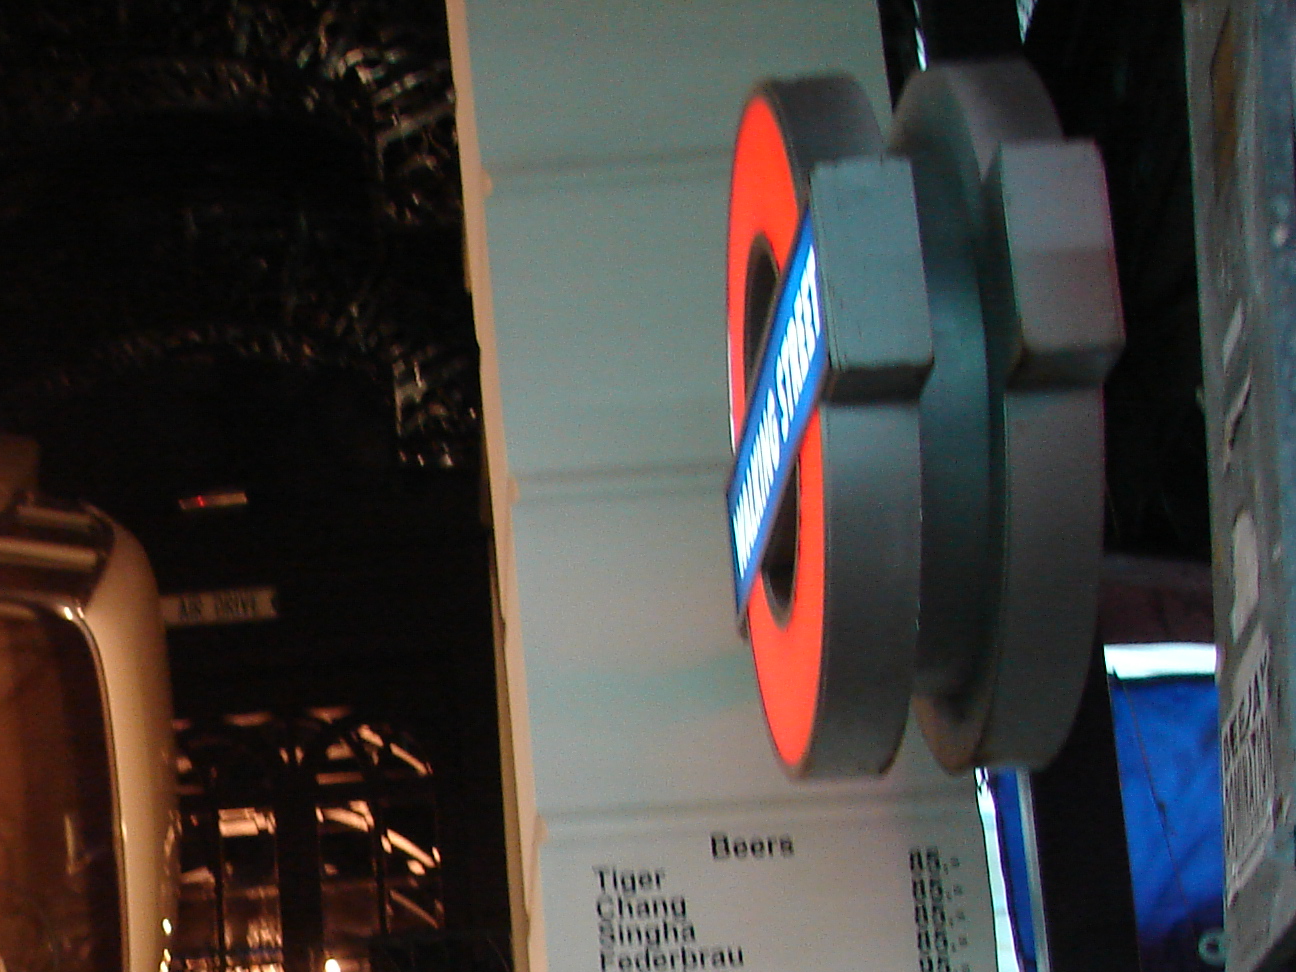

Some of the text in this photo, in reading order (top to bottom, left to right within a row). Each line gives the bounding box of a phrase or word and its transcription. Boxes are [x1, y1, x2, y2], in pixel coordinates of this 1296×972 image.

[732, 243, 822, 580] WALKING STREET
[710, 832, 795, 861] Beers
[594, 864, 666, 896] Tiger
[596, 893, 688, 922] Chang
[598, 919, 696, 948] Singha
